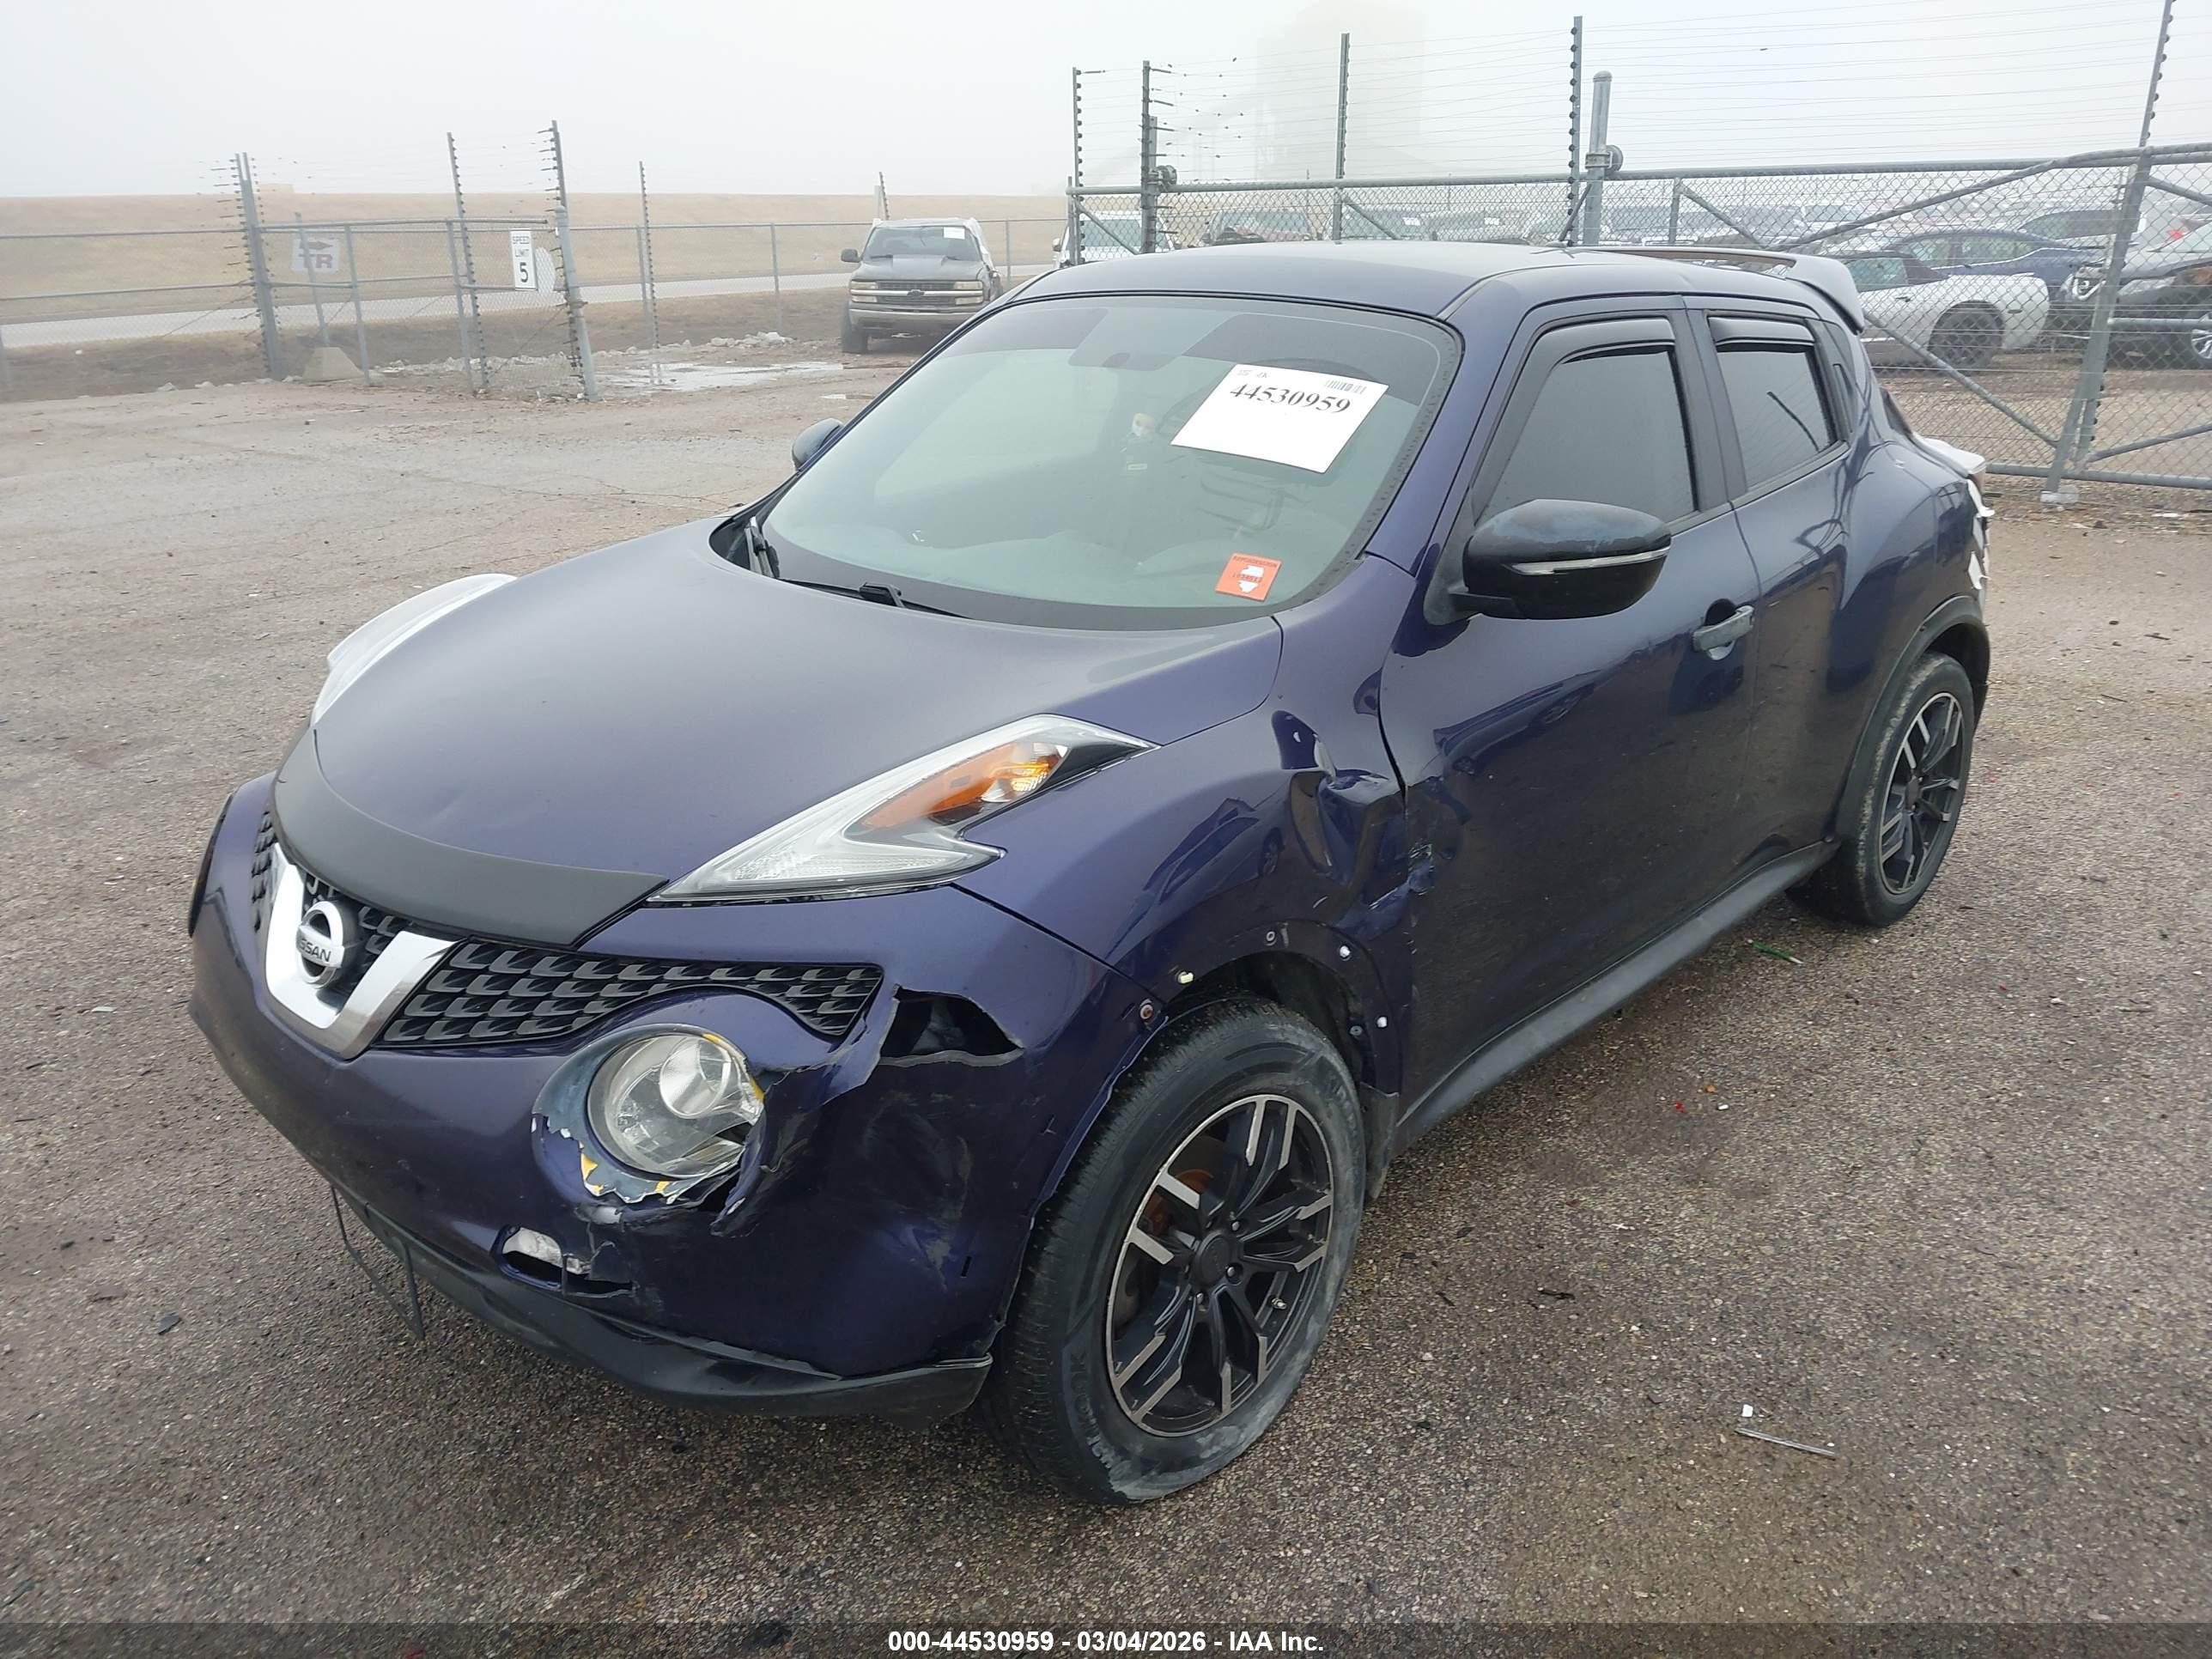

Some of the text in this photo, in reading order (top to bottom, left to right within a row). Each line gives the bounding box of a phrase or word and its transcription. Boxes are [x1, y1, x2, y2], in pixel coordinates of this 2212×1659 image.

[512, 235, 530, 245] SPEED
[519, 261, 529, 283] 5
[1229, 383, 1352, 413] 44530959
